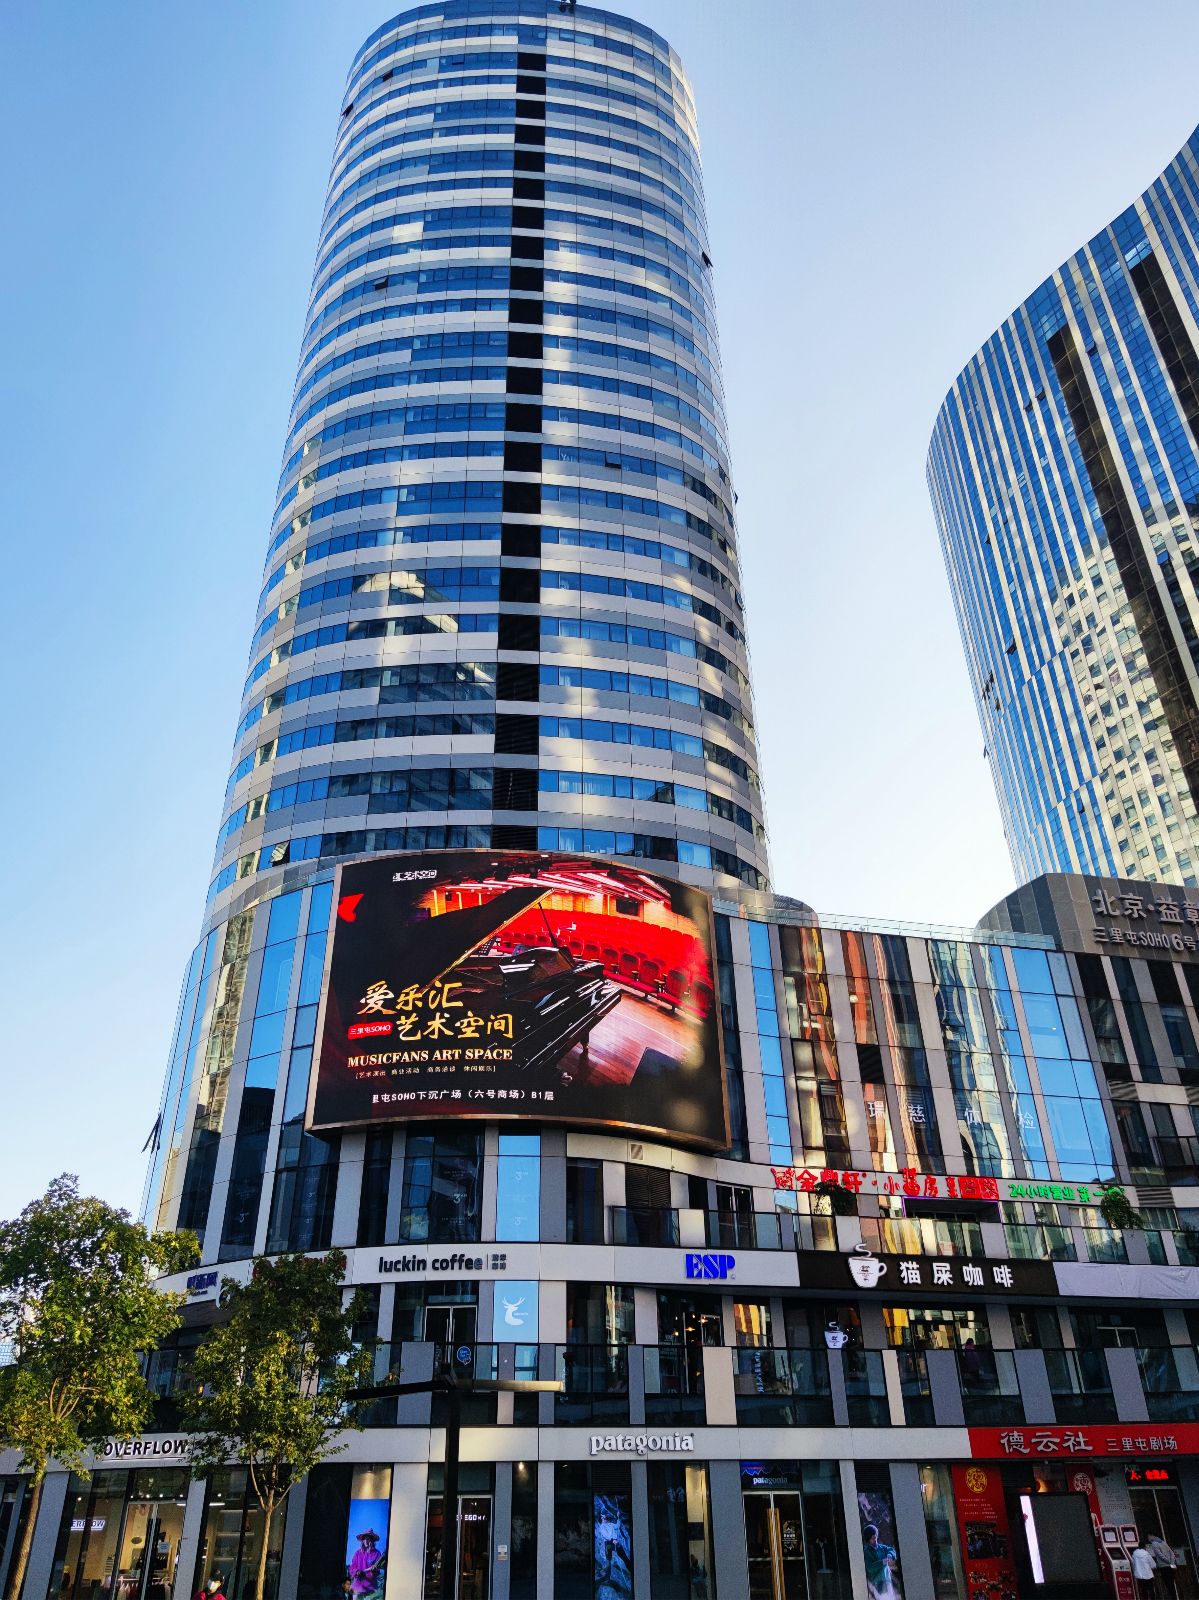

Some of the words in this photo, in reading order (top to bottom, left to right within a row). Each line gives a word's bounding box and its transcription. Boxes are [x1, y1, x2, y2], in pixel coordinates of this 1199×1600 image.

[356, 980, 464, 1015] 爱乐汇
[396, 1011, 514, 1041] 艺术空间
[347, 1050, 429, 1067] MUSICFANS
[432, 1049, 462, 1062] ART
[465, 1048, 513, 1060] SPACE
[868, 1101, 1036, 1129] 瑞慈体检
[379, 1255, 427, 1273] luckin
[431, 1254, 483, 1271] coffee
[686, 1254, 736, 1279] ESP
[900, 1261, 1014, 1288] 猫屎咖啡
[104, 1440, 188, 1457] OVERFLOW
[590, 1432, 694, 1455] patagonia
[1001, 1431, 1093, 1454] 德云社
[1107, 1436, 1178, 1451] 三里屯剧场
